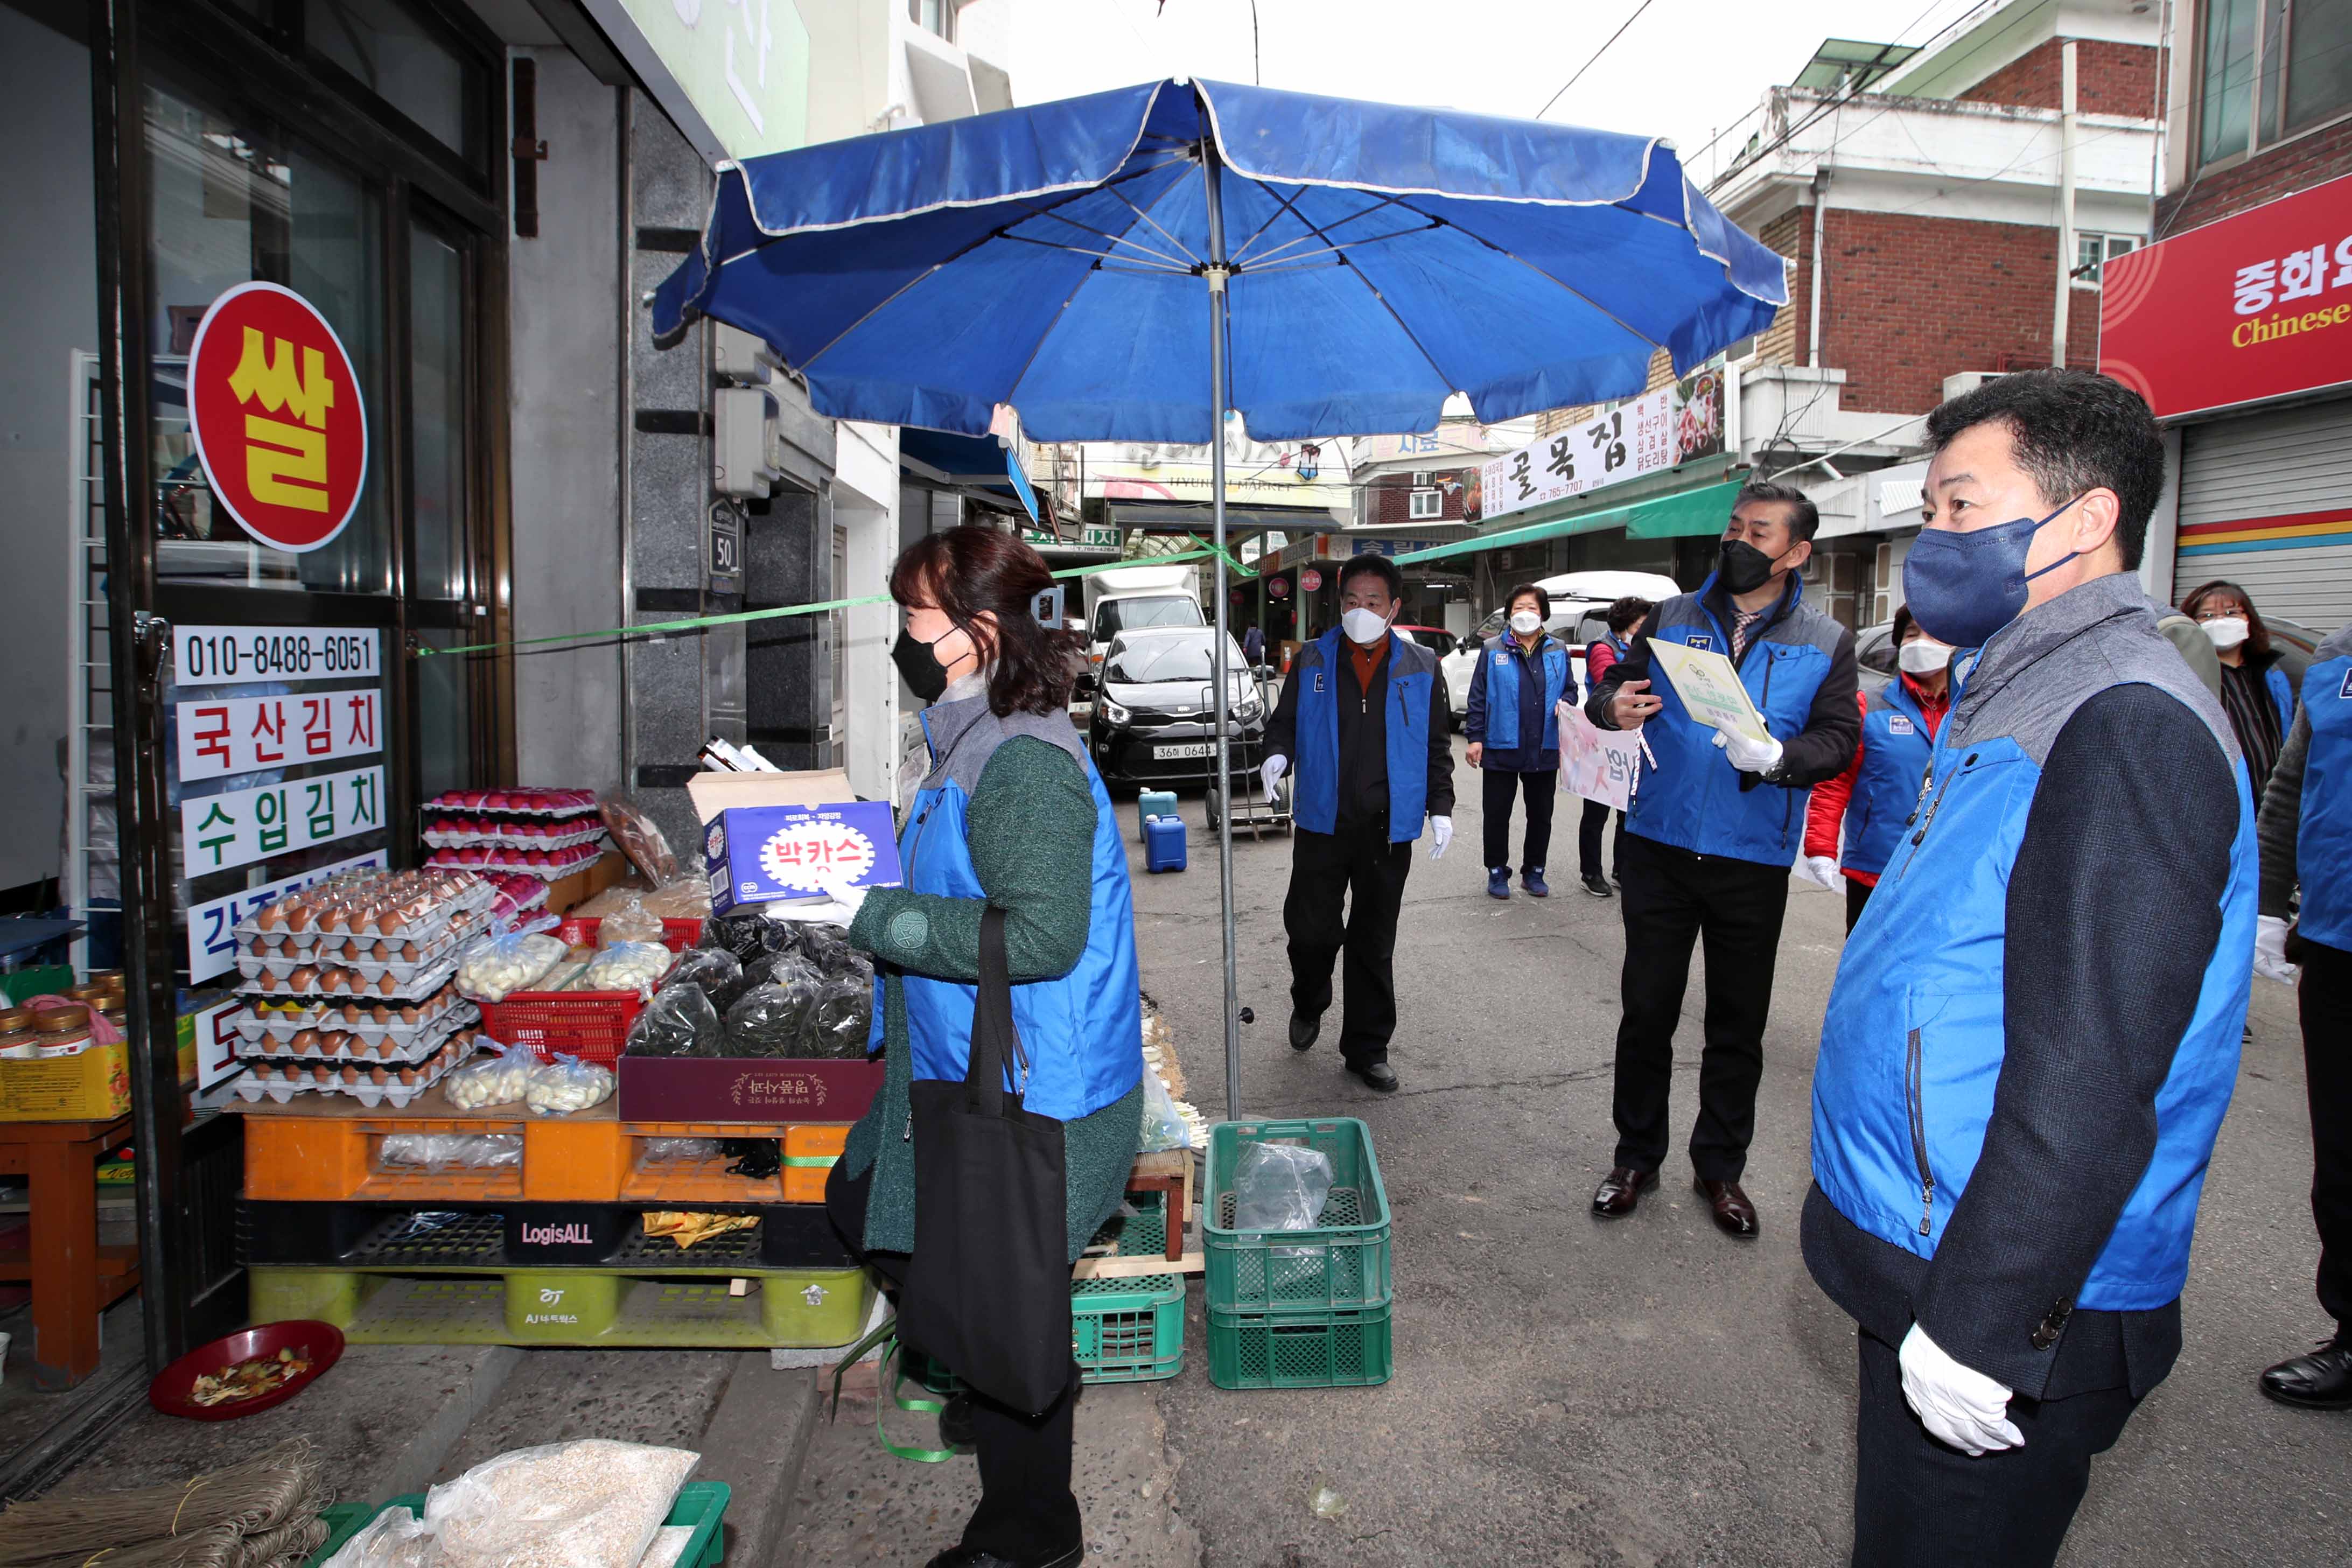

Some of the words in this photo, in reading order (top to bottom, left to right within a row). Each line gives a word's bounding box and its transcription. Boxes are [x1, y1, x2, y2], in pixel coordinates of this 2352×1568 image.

[2231, 303, 2350, 348] Chinese
[227, 325, 334, 513] 쌀
[1237, 481, 1292, 492] MARKET
[718, 537, 731, 566] 50
[187, 635, 371, 677] 010-8488-6051
[775, 838, 862, 866] 박카스
[748, 1080, 809, 1095] 명품사과
[522, 1223, 592, 1245] LogisALL
